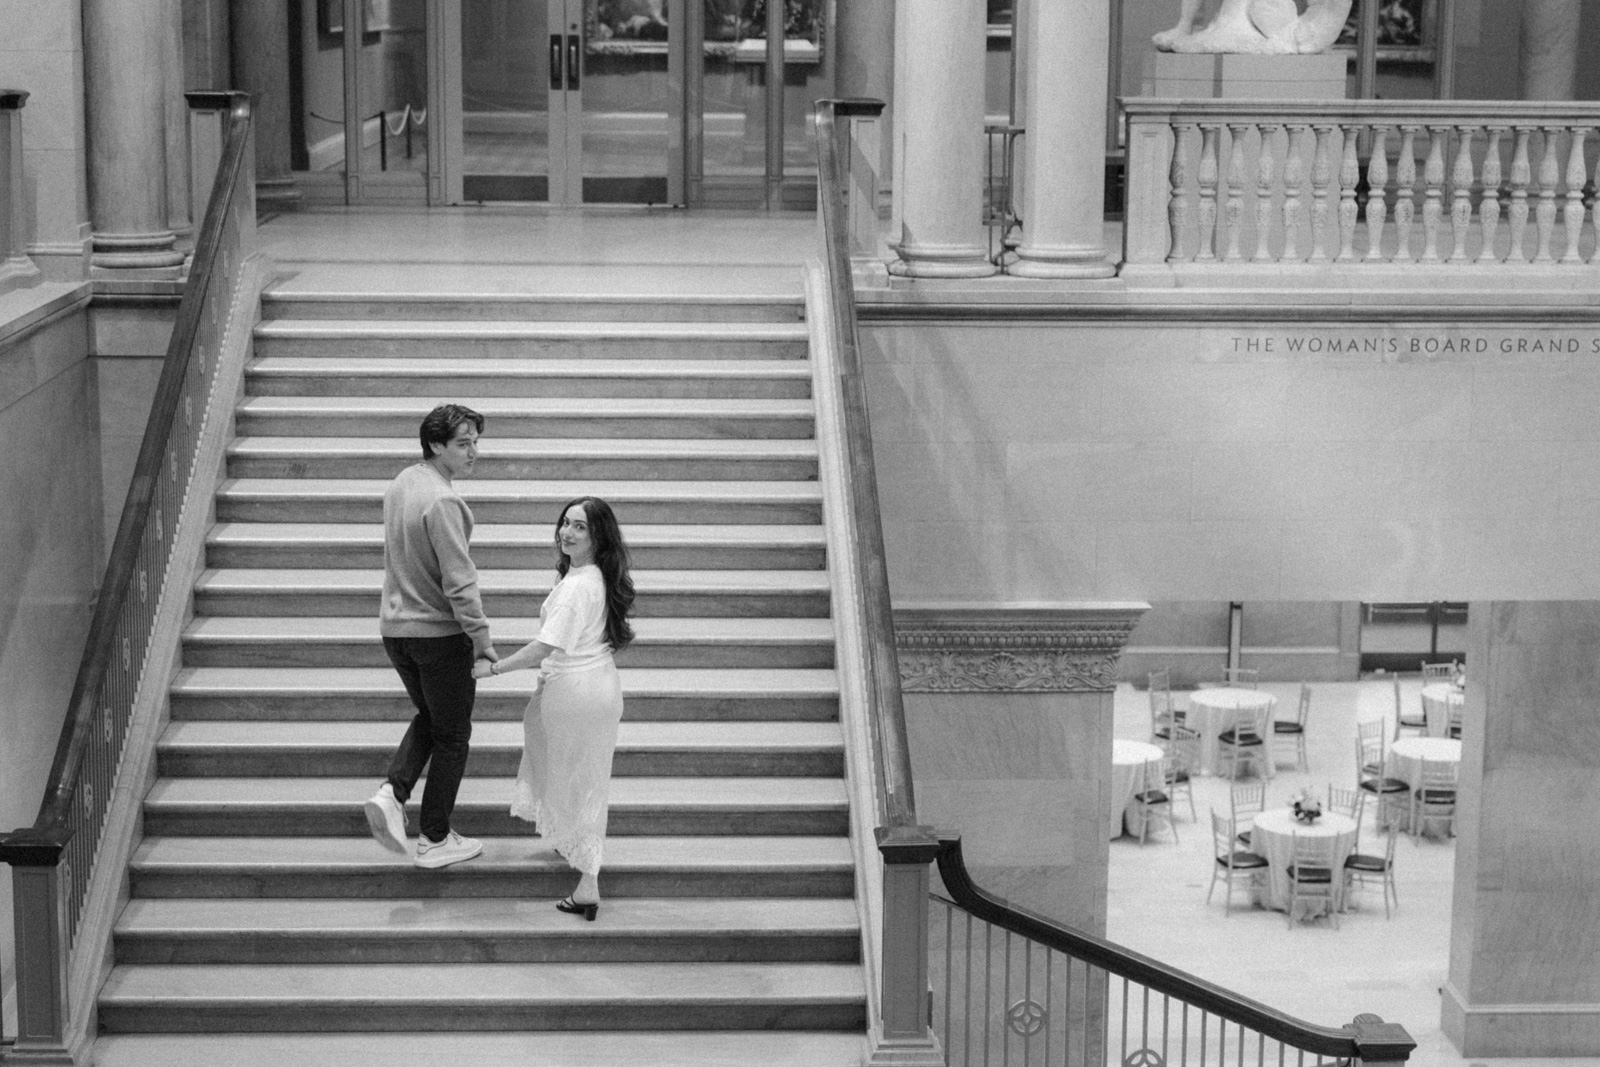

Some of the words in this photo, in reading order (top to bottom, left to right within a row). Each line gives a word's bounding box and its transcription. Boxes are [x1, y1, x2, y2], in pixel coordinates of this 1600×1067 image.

[1232, 337, 1275, 353] THE
[1285, 337, 1398, 353] WOMAN'S
[1410, 337, 1488, 353] BOARD
[1499, 337, 1580, 353] GRAND
